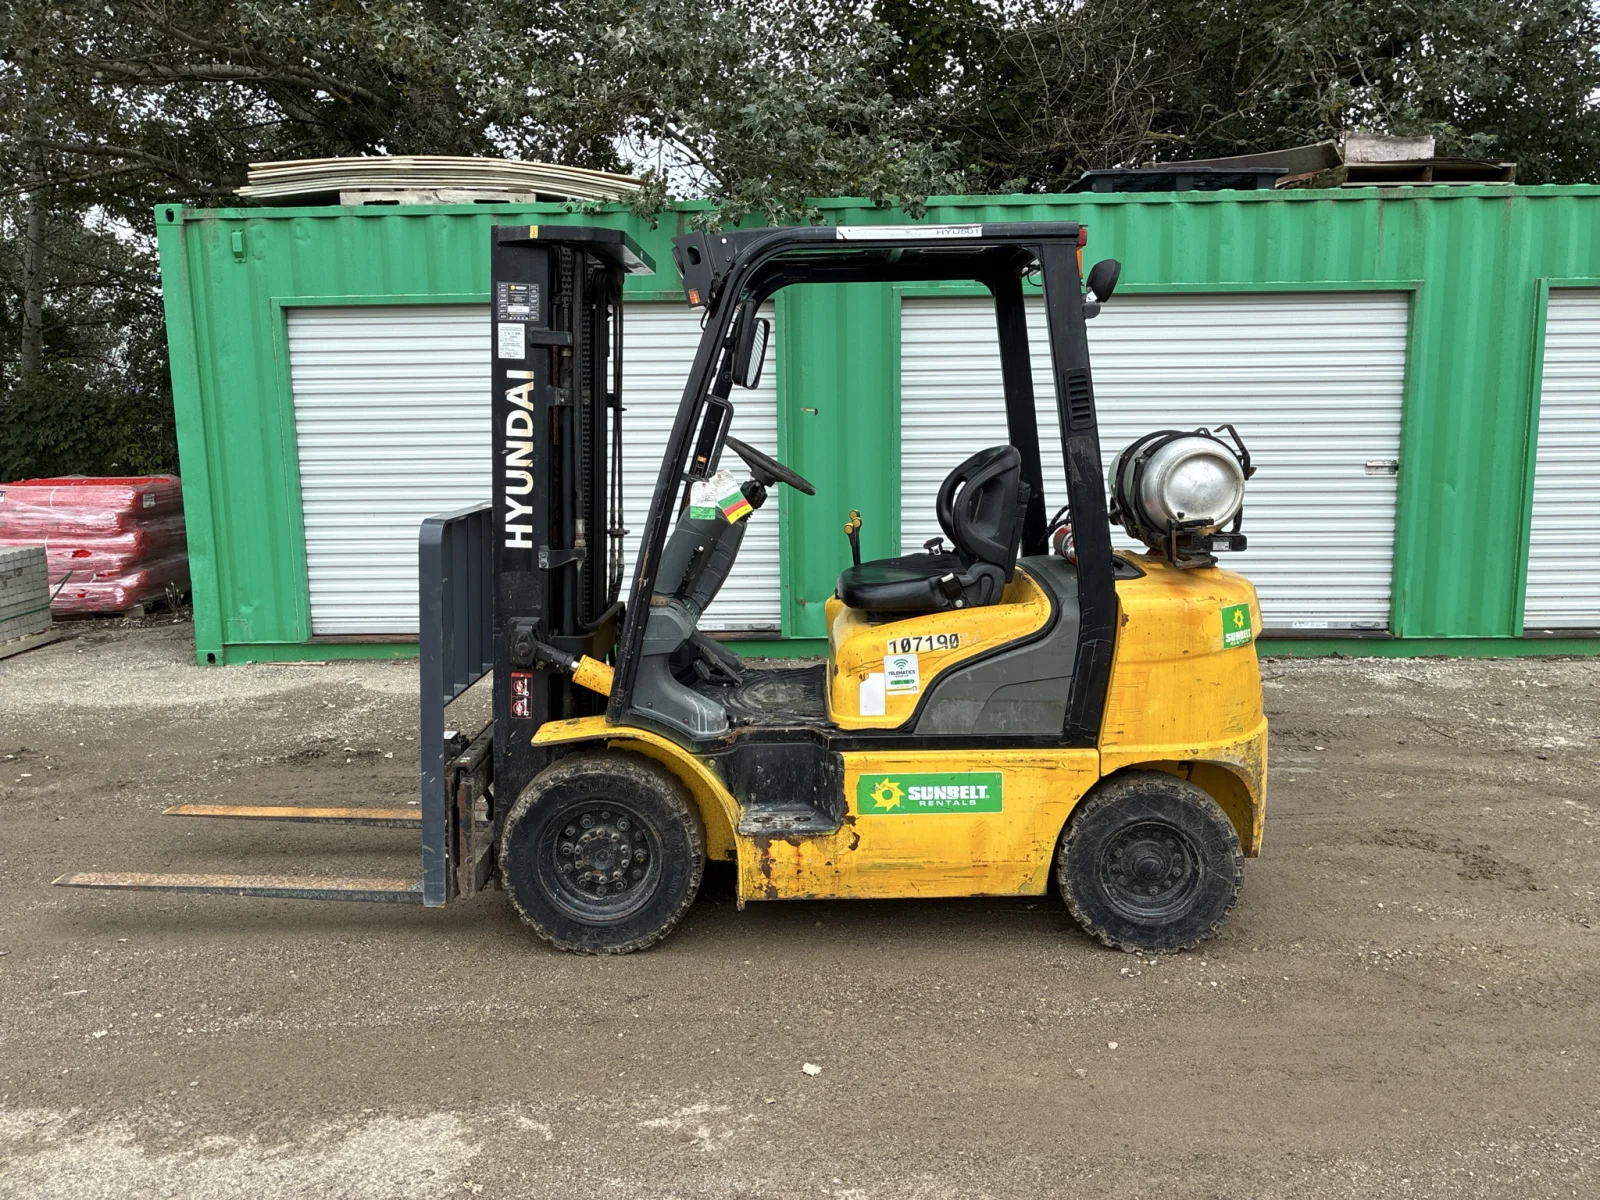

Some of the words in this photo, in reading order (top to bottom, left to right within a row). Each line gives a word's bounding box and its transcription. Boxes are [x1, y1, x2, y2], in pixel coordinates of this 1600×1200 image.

[505, 369, 534, 549] HYUNDAI
[889, 633, 960, 654] 107190
[908, 785, 989, 801] SUNBELT
